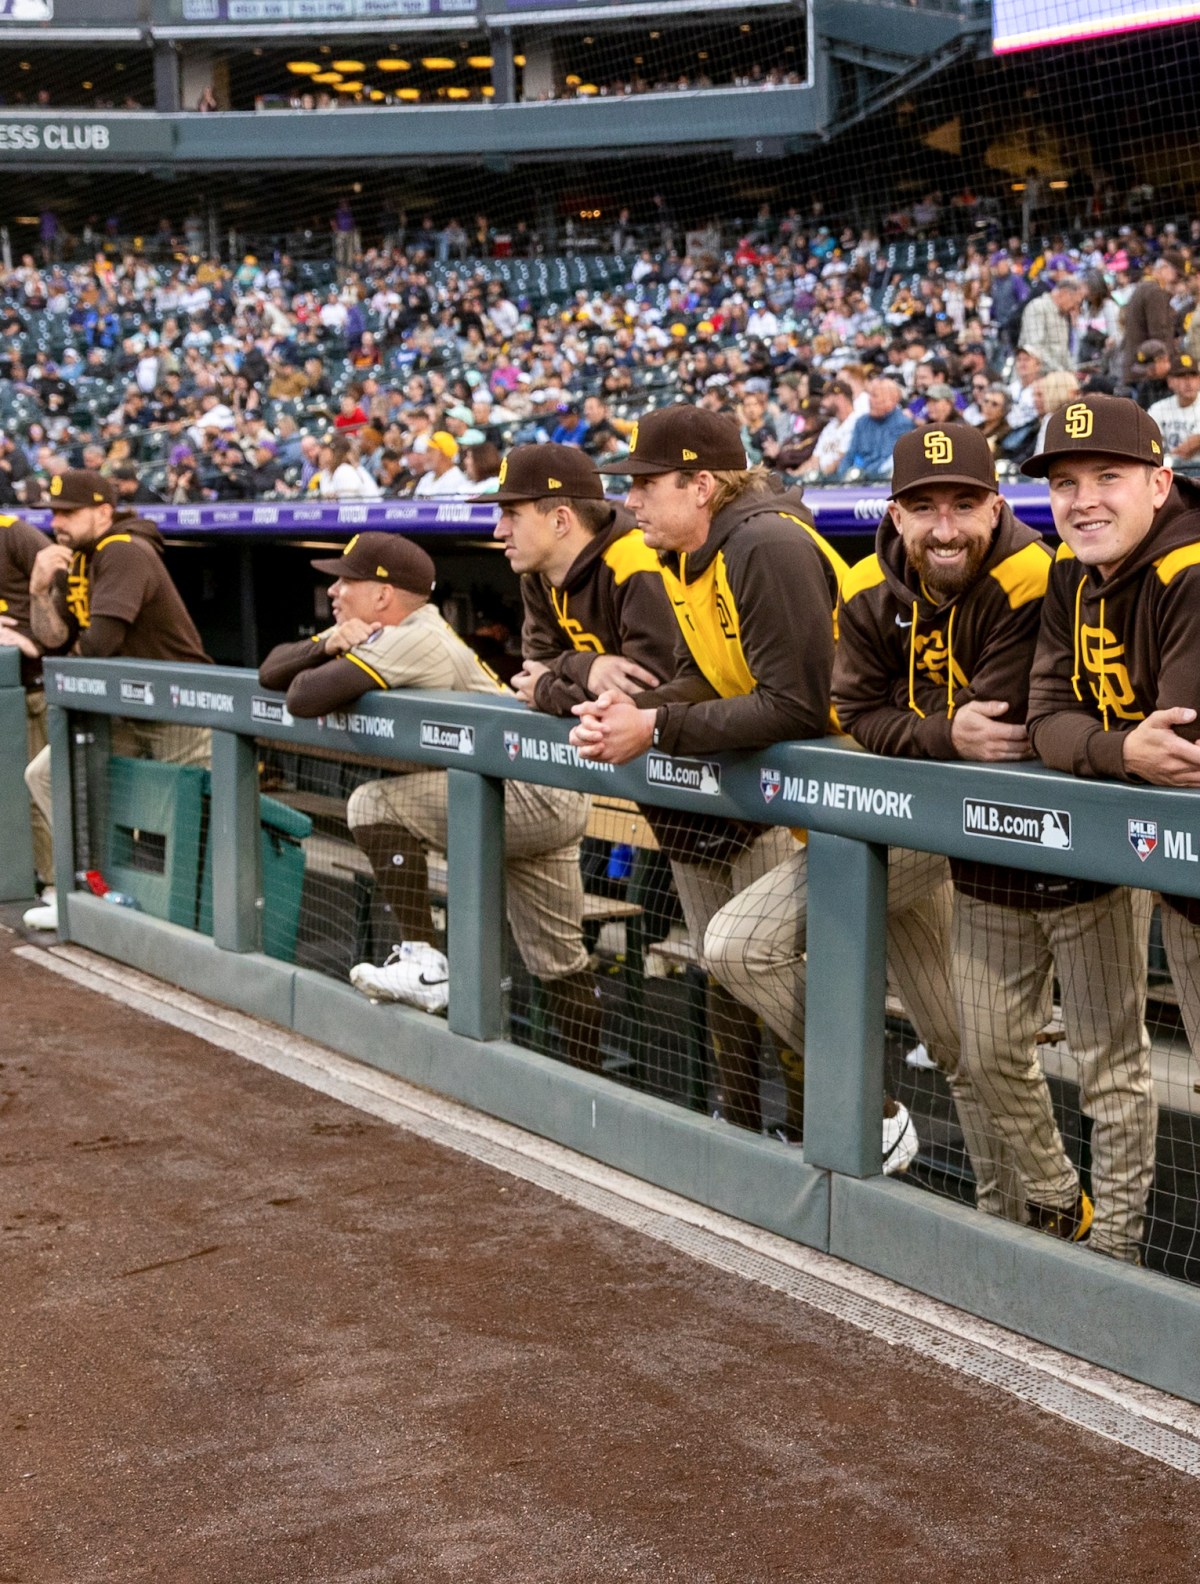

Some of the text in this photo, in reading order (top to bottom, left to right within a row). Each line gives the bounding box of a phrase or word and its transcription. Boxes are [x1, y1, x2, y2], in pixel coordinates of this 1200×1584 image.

[43, 124, 110, 150] CLUB
[1065, 403, 1094, 439] SD
[924, 430, 953, 465] SD
[179, 688, 195, 707] MLB
[196, 691, 234, 713] NETWORK
[252, 701, 282, 719] MLB.com
[347, 714, 395, 739] NETWORK
[422, 725, 459, 747] MLB.com
[521, 737, 549, 761] MLB
[649, 758, 700, 787] MLB.com
[783, 776, 913, 819] MLB NETWORK
[966, 804, 1039, 838] MLB.com
[1130, 821, 1155, 835] MLB
